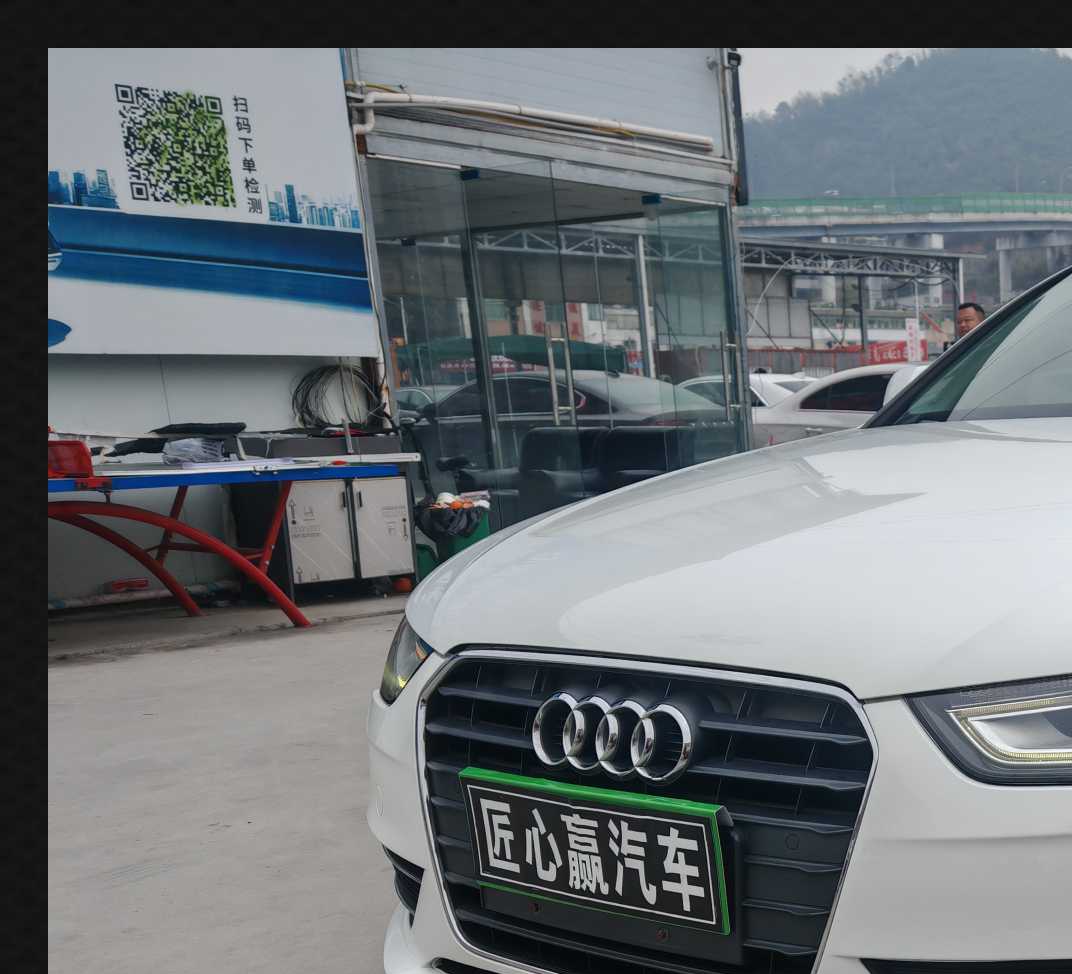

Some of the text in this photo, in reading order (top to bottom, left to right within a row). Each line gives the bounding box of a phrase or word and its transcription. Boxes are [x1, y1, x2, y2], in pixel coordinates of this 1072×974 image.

[233, 95, 263, 215] 扫码下单检测
[480, 798, 705, 912] 匠心赢汽车
